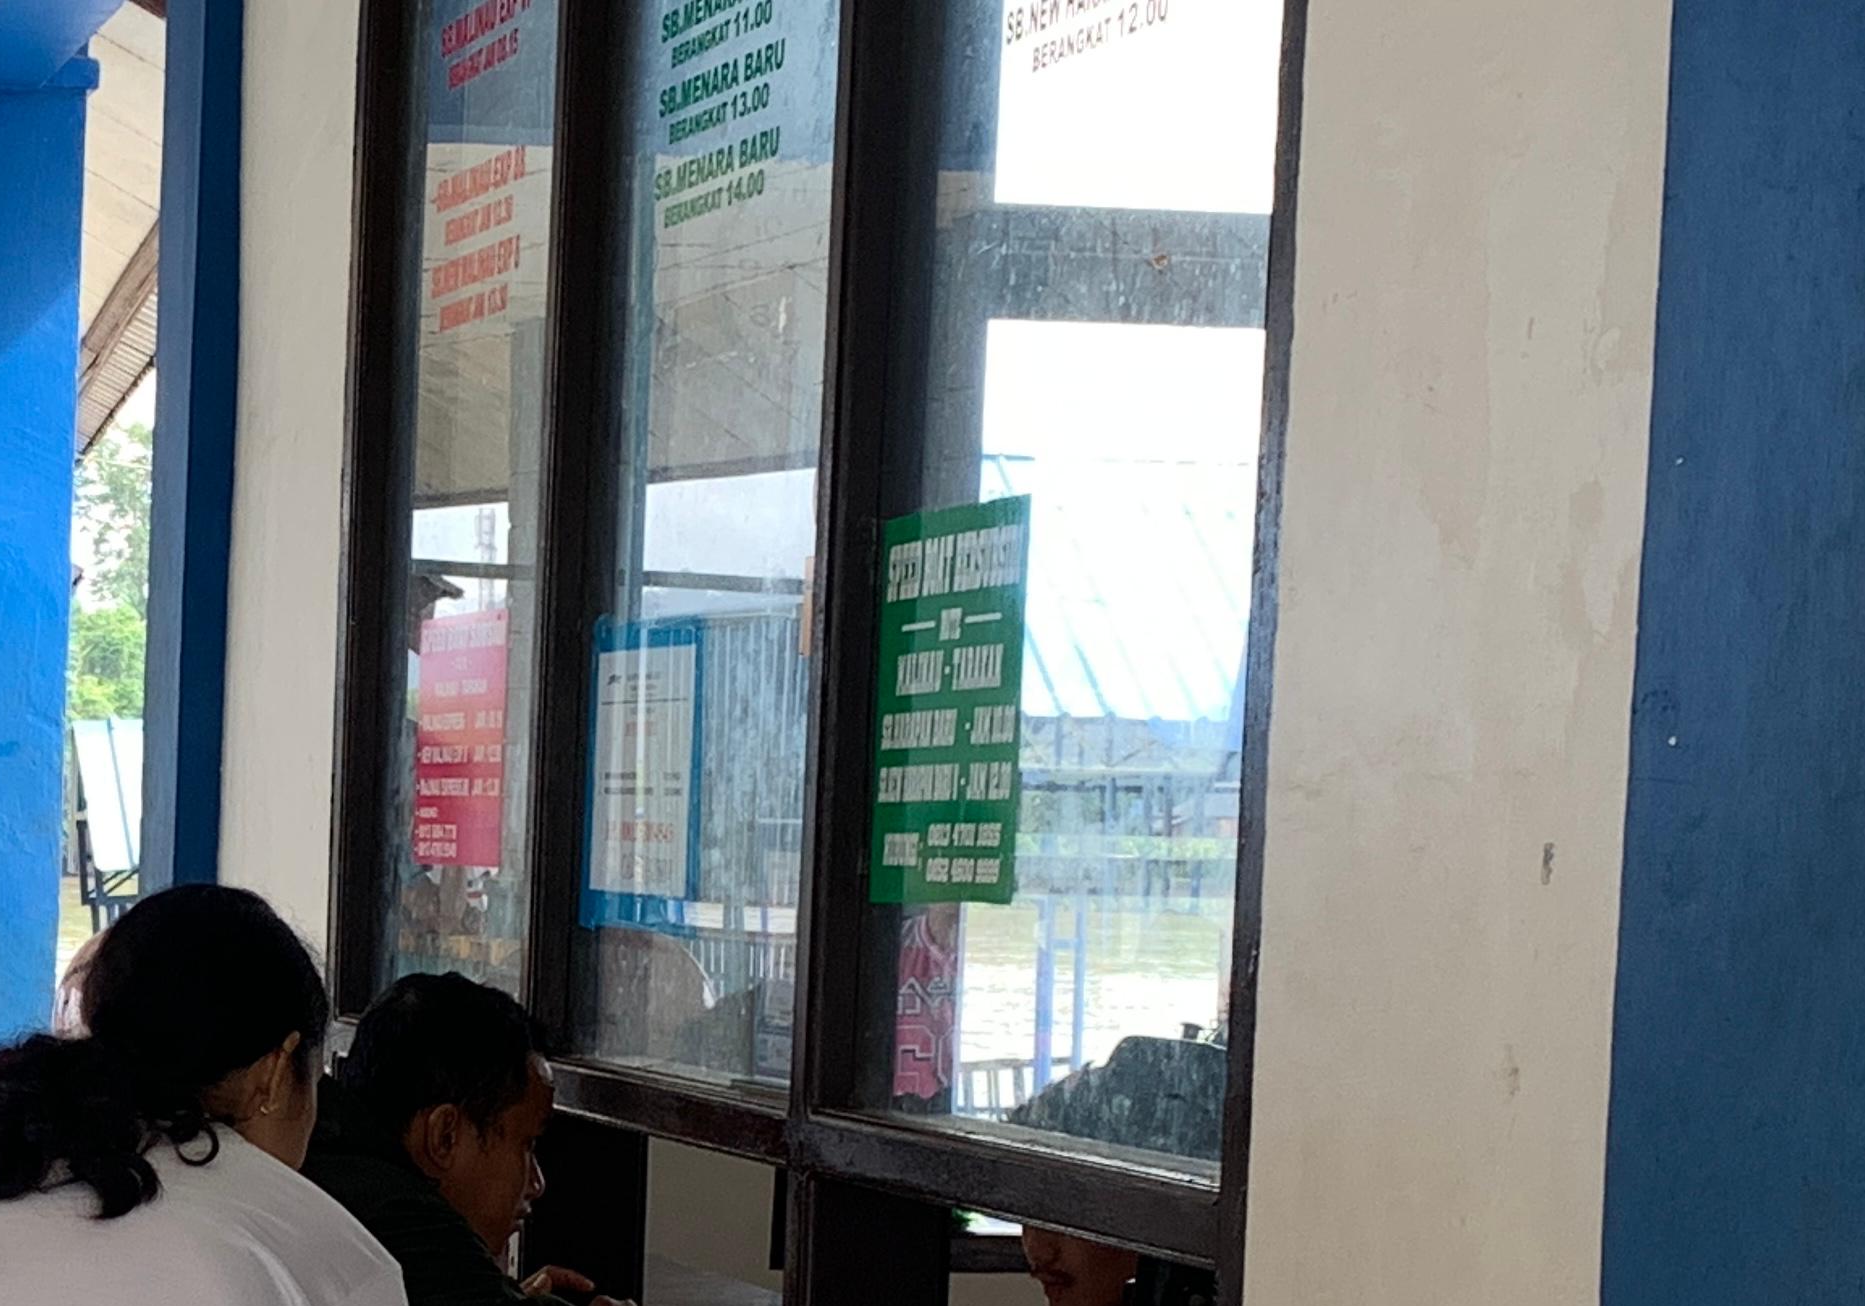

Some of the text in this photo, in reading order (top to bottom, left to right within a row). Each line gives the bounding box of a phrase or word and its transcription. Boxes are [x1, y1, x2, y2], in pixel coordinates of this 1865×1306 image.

[672, 0, 772, 69] BERANGKAT 11.00
[1032, 0, 1169, 72] BERANGKAT 12.00
[659, 38, 785, 118] SB.MENARA BARU
[669, 83, 770, 145] BERANGKAT 13.00
[654, 126, 780, 200] SB.MENARA BARU
[664, 169, 764, 228] BERANGKAT 14.00
